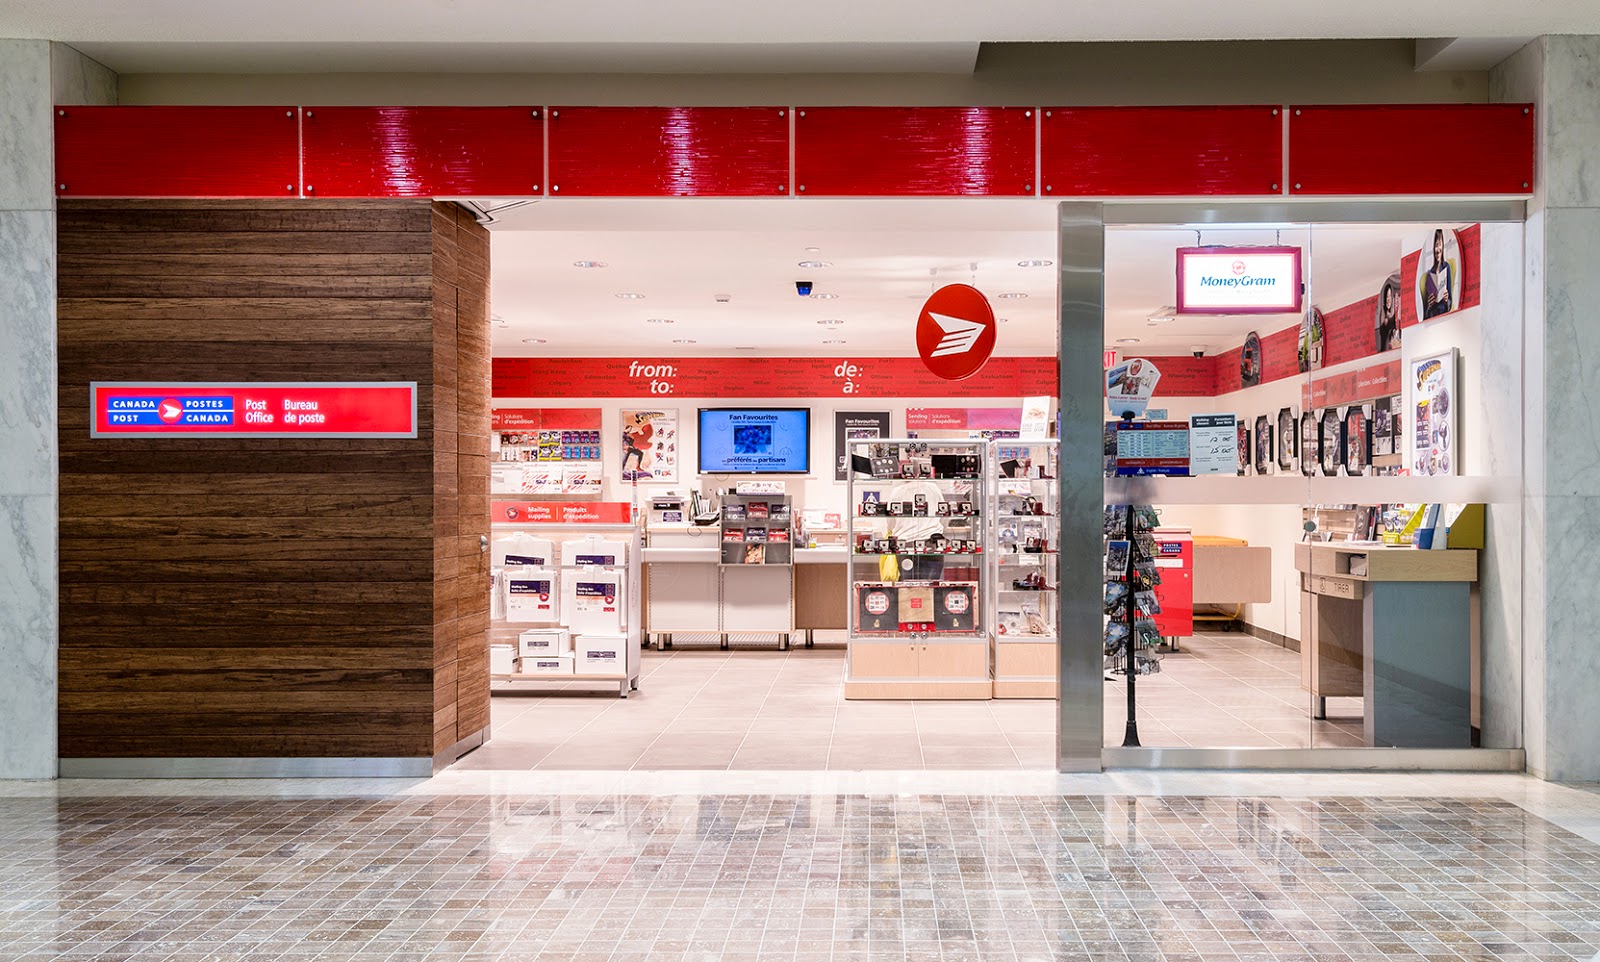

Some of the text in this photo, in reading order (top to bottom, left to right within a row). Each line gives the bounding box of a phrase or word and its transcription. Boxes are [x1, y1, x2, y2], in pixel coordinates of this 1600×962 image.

[1200, 276, 1276, 288] MoneyGram
[628, 361, 678, 378] from:
[833, 361, 864, 378] de:
[650, 379, 675, 395] to:
[842, 378, 861, 395] à:
[112, 400, 224, 408] CANADA POSTES
[246, 399, 266, 410] Post
[284, 399, 318, 410] Bureau
[245, 412, 274, 424] Office
[284, 412, 325, 426] de poste
[528, 506, 550, 514] Mailing
